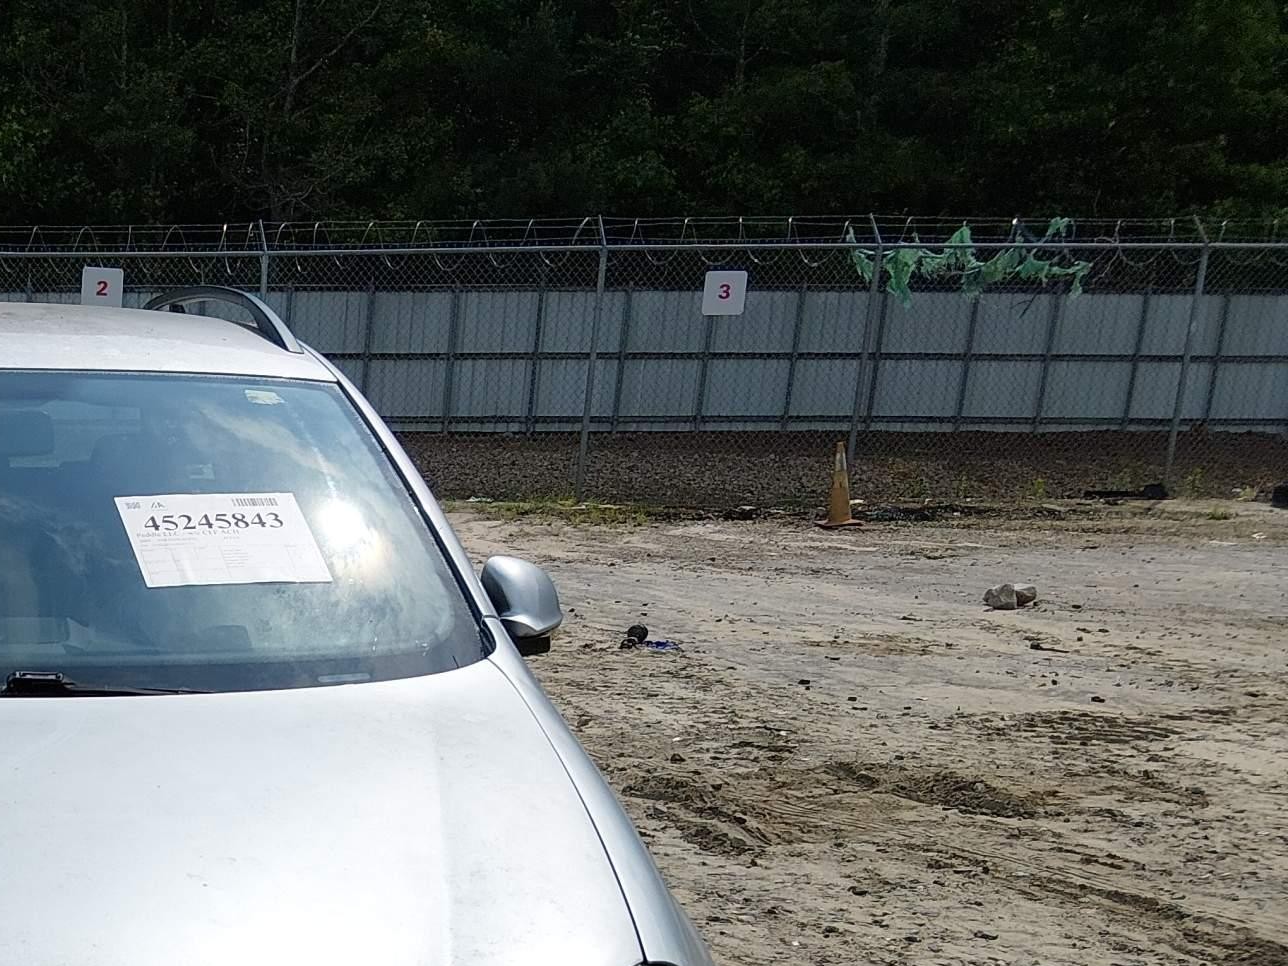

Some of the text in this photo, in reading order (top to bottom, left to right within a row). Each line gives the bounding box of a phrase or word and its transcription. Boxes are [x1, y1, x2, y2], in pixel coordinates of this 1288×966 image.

[95, 280, 108, 297] 2
[718, 283, 731, 300] 3
[143, 512, 284, 532] 45245843
